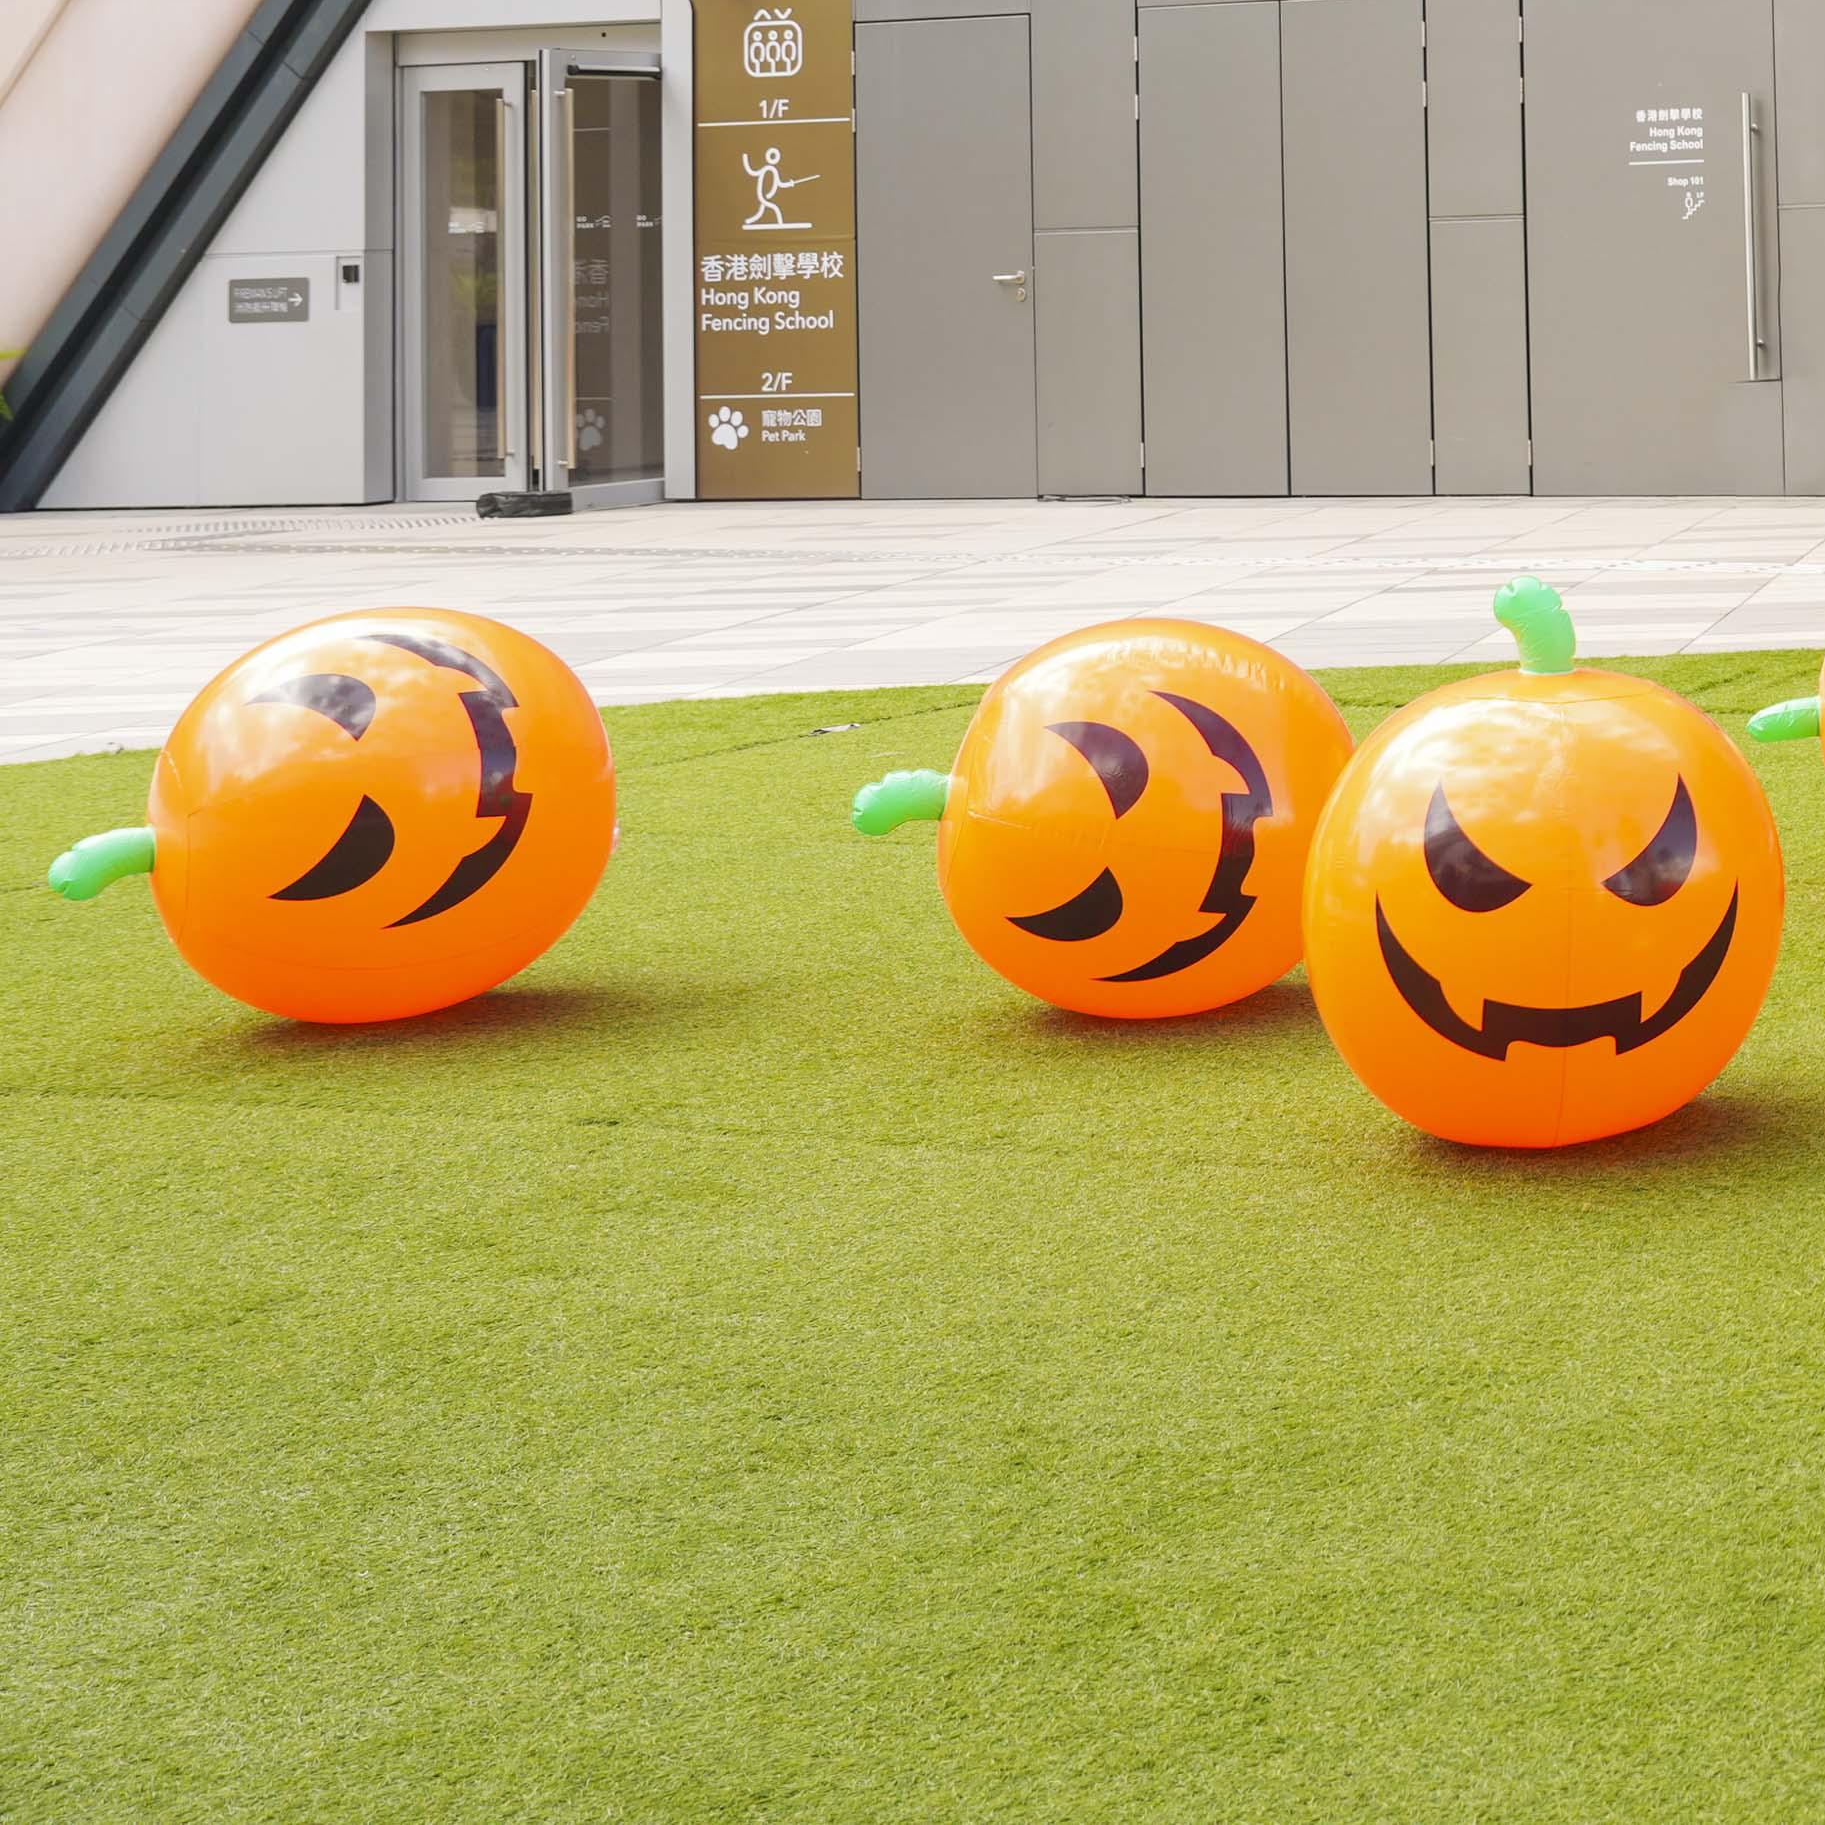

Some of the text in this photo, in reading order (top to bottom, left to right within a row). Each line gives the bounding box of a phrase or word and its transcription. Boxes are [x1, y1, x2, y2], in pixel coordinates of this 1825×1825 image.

[759, 98, 790, 119] 1/F
[1648, 124, 1704, 139] Hong Kong
[1629, 138, 1704, 153] Fencing School
[701, 251, 845, 283] 香港劍擊學校
[701, 286, 801, 310] Hong Kong
[701, 309, 835, 336] Fencing School
[761, 372, 793, 392] 2/F
[761, 429, 807, 442] Pet Park
